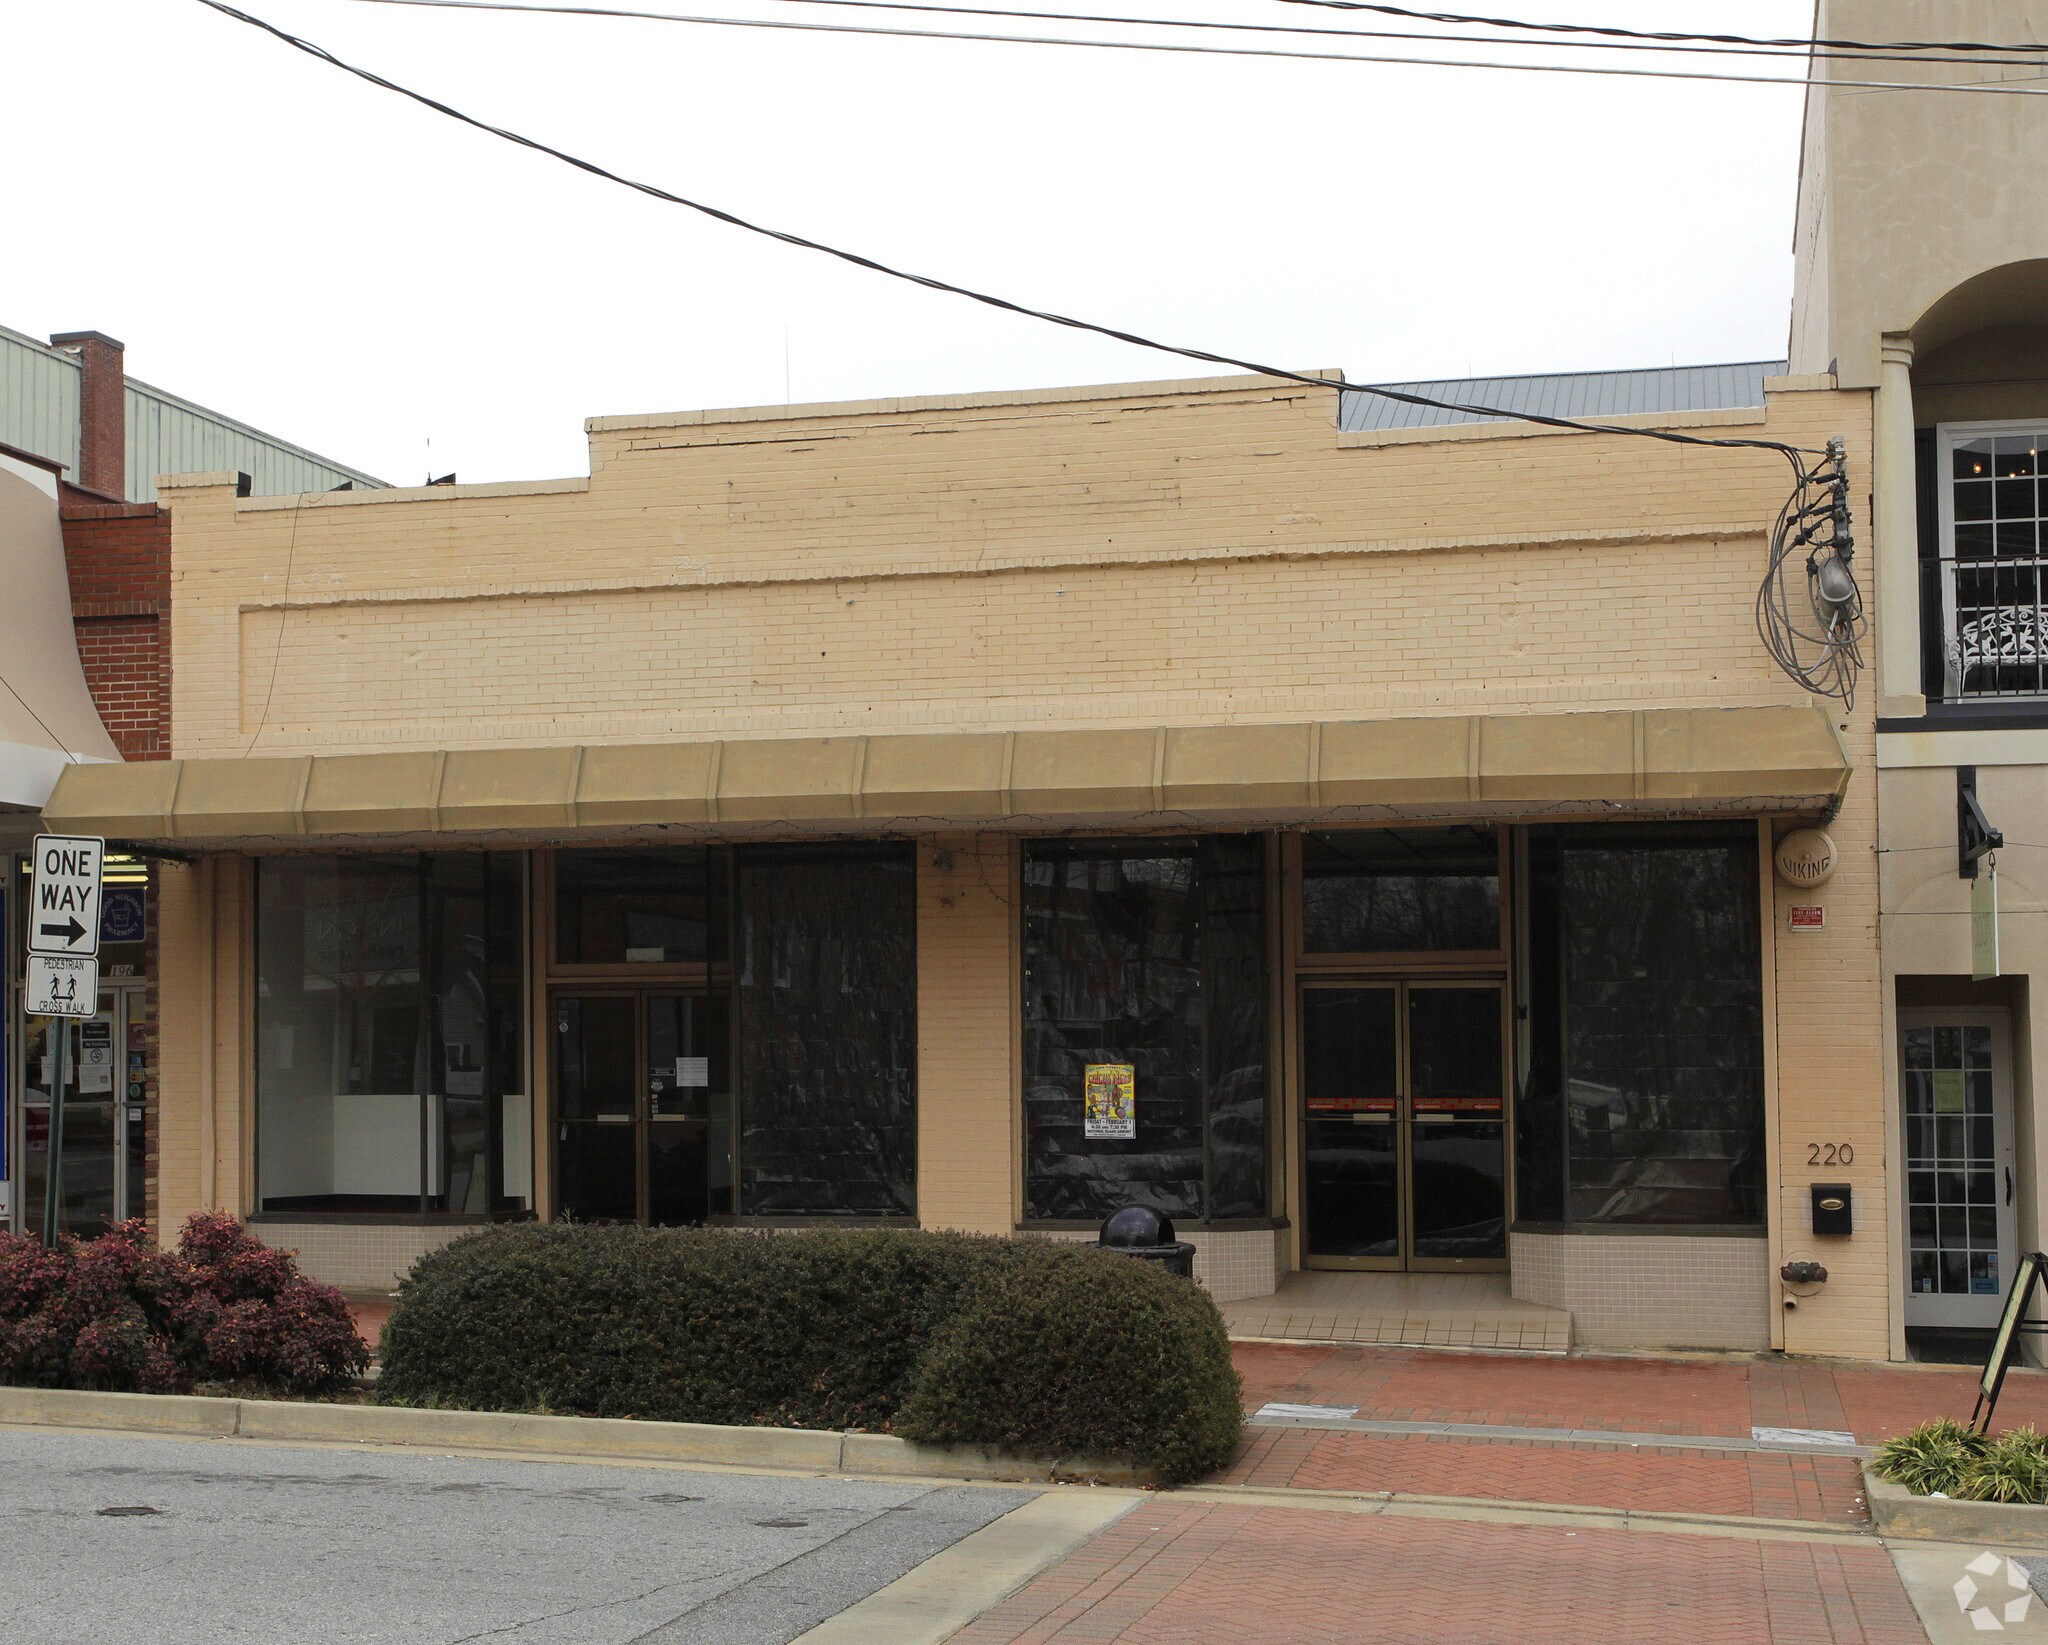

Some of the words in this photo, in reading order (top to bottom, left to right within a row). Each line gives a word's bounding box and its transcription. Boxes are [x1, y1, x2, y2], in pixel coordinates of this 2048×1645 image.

[45, 849, 92, 877] ONE
[1783, 856, 1830, 879] VIKING
[41, 883, 92, 912] WAY
[101, 897, 114, 918] GOOD
[114, 894, 143, 917] NEIGHBOR
[104, 922, 139, 936] PHARMACY
[43, 958, 84, 971] PEDESTRIAN
[112, 965, 134, 976] 196
[39, 1000, 63, 1012] CROSS
[66, 1001, 86, 1014] WALK
[1807, 1142, 1854, 1165] 220
